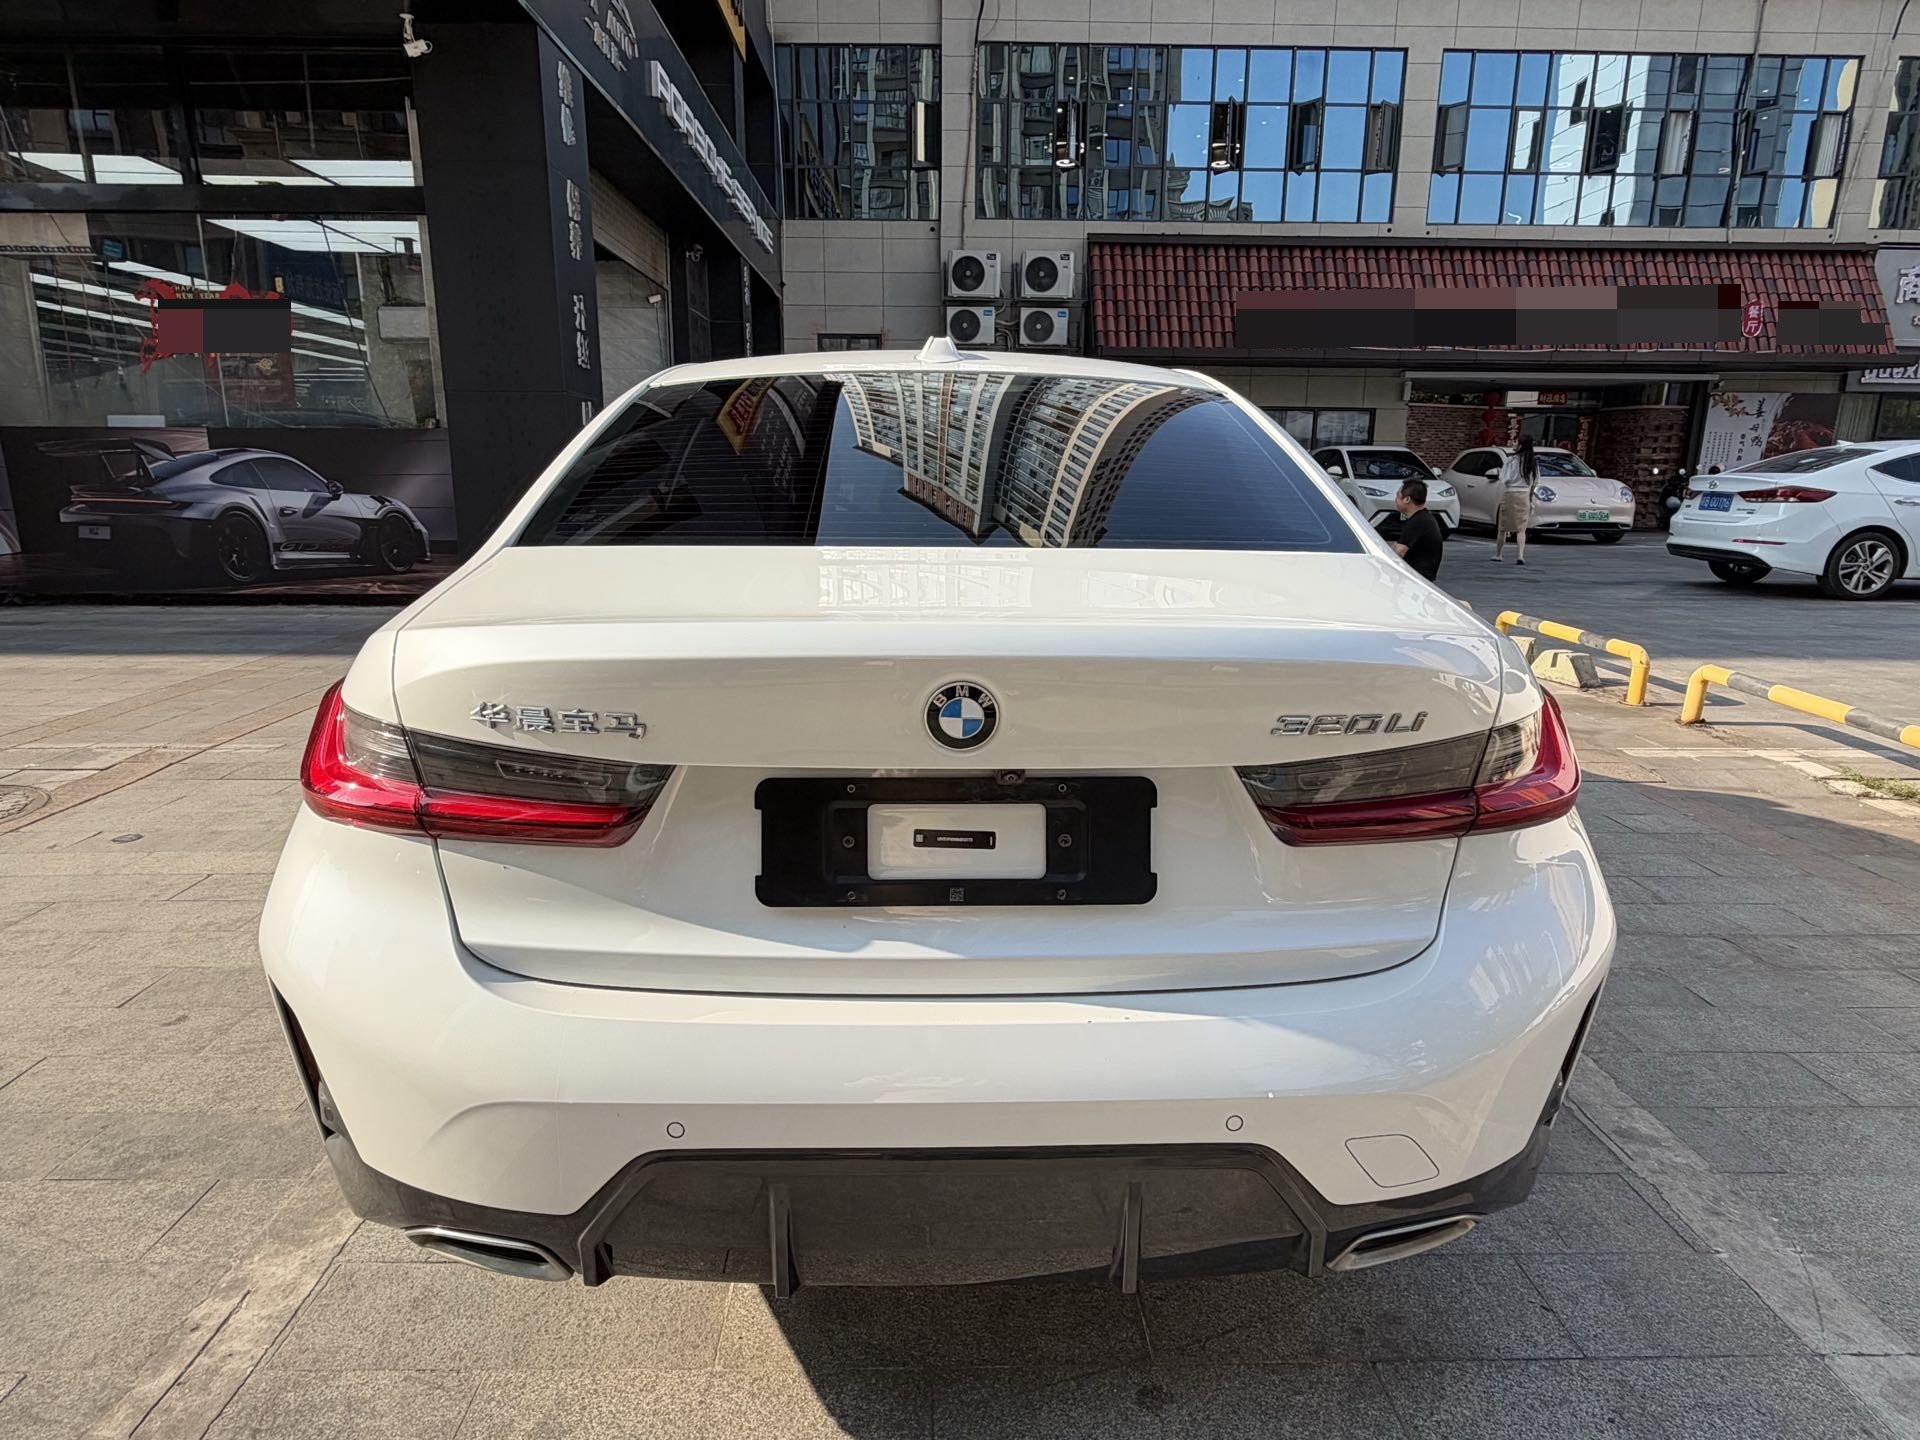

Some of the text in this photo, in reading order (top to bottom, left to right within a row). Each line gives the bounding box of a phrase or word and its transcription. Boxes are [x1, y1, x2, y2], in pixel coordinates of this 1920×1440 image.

[1744, 304, 1760, 333] 餐厅
[933, 684, 993, 708] BMW
[469, 701, 647, 740] 华晨宝马
